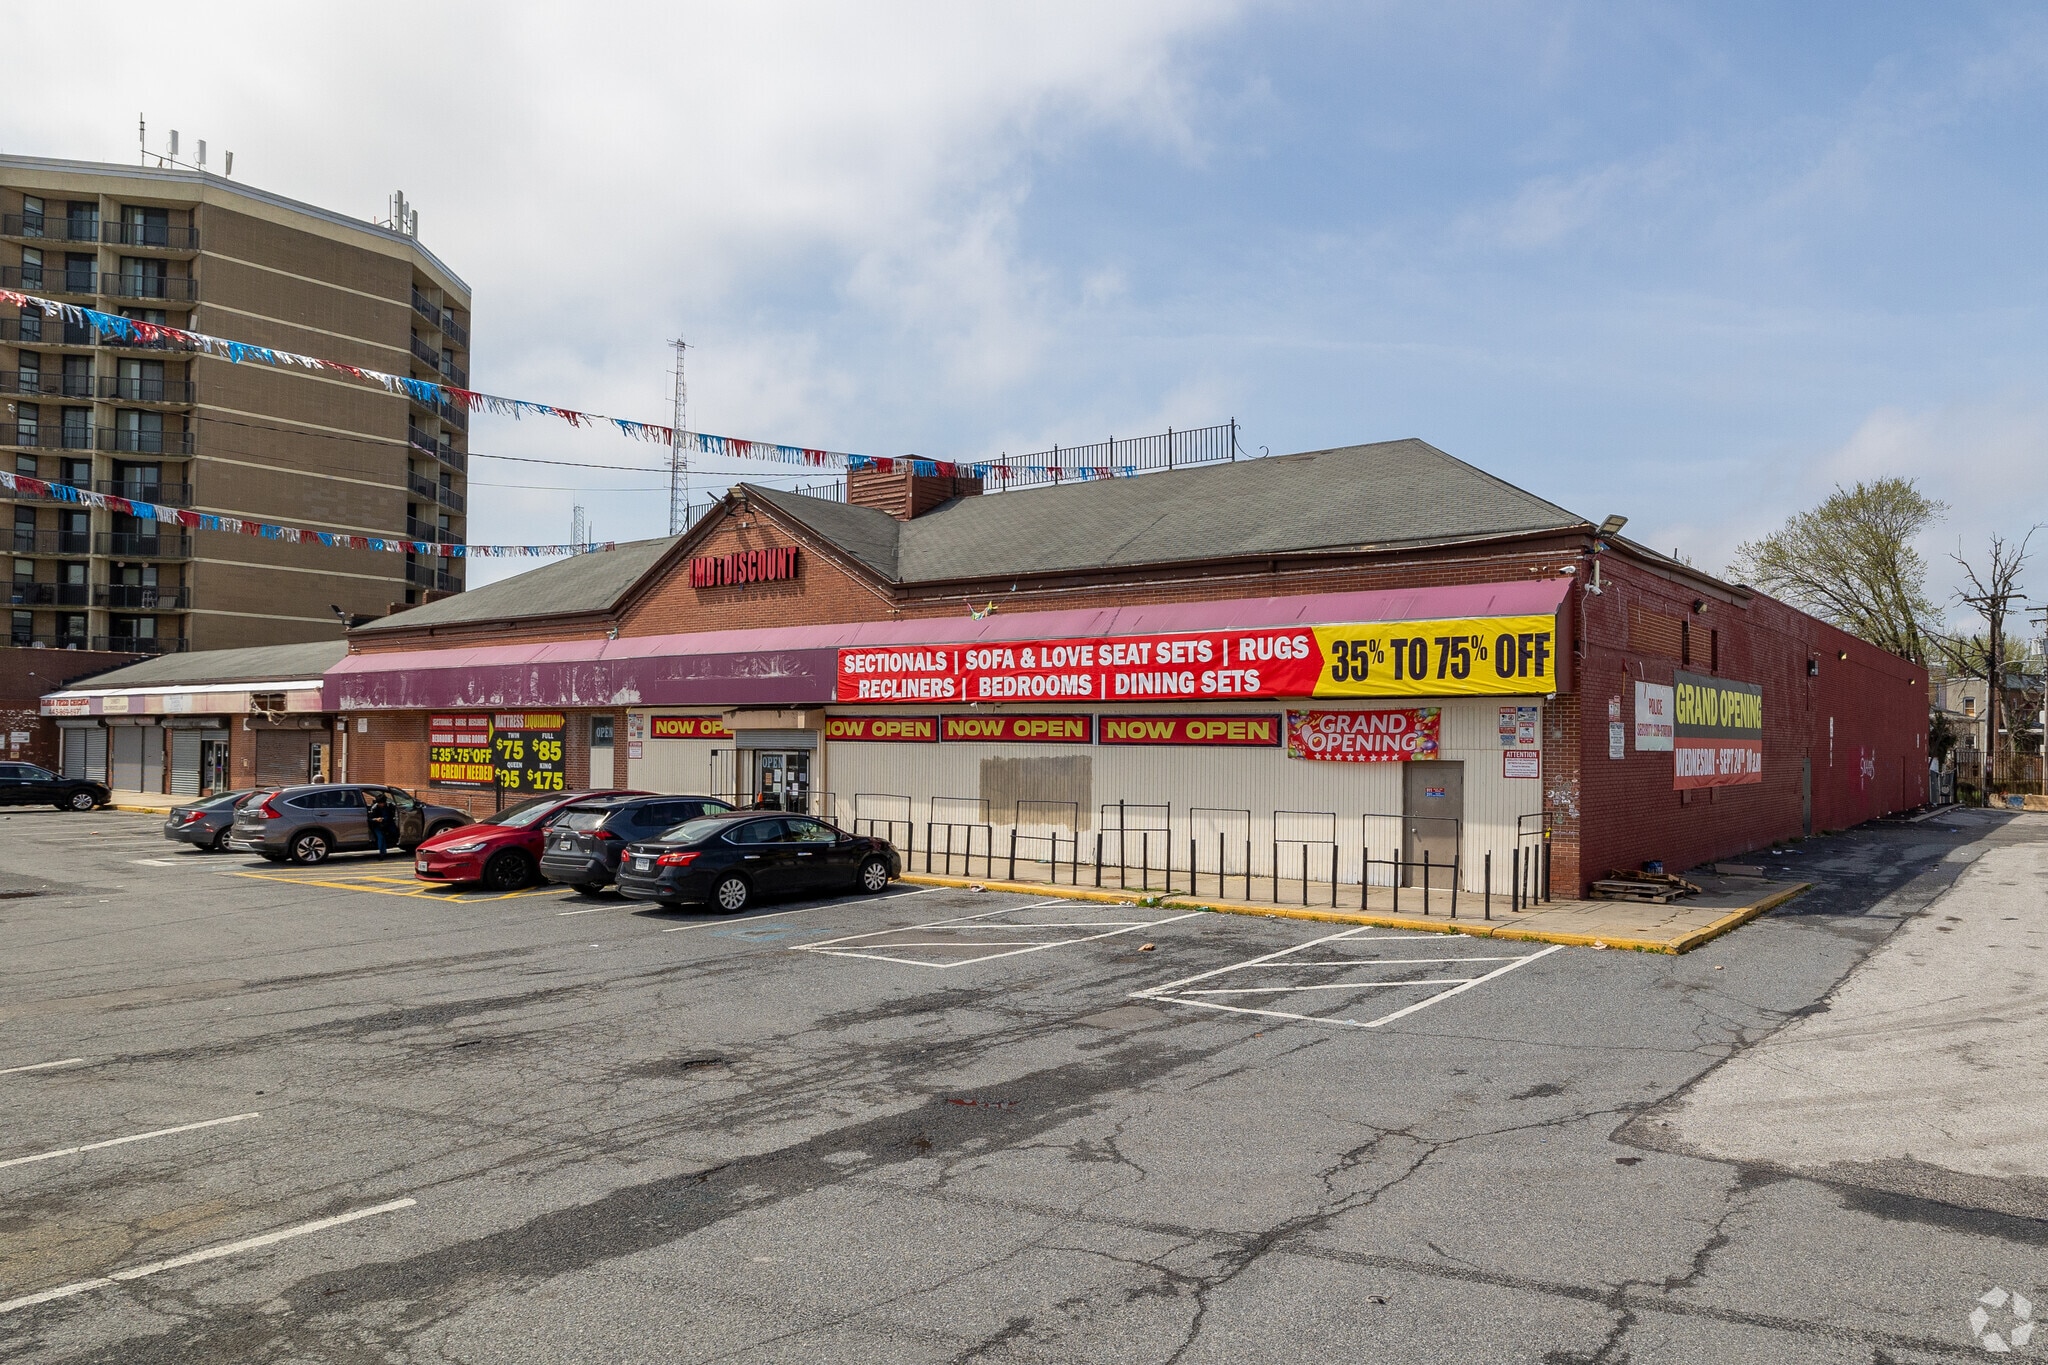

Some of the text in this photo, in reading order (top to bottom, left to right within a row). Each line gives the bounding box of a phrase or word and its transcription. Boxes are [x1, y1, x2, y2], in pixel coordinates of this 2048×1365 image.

[844, 651, 948, 674] SECTIONALS
[965, 649, 1015, 671] SOFA
[1020, 648, 1037, 669] &
[1041, 645, 1093, 668] LOVE
[1098, 642, 1151, 666] SEAT
[1156, 640, 1213, 663] SETS
[1239, 635, 1309, 661] RUGS
[1331, 632, 1551, 682] 35% TO 75% OFF
[858, 677, 955, 698] RECLINERS
[979, 674, 1092, 697] BEDROOMS
[1115, 671, 1195, 695] DINING
[1200, 669, 1260, 693] SETS
[1648, 697, 1663, 716] POLICE
[1676, 682, 1762, 729] GRAND OPENING
[495, 714, 561, 729] MATTRESS LIQUIDATION
[656, 720, 695, 734] NOW
[700, 720, 733, 734] OP
[871, 721, 931, 737] OPEN
[947, 720, 1082, 737] NOW OPEN
[1107, 721, 1269, 740] NOW OPEN
[596, 726, 613, 738] OPEN
[1308, 713, 1418, 752] GRAND OPENING
[496, 737, 562, 761] $75 $85
[506, 761, 523, 769] QUEEN
[762, 756, 784, 768] OPEN
[1675, 748, 1715, 777] WEDNESDAY
[1719, 748, 1734, 775] SEPT
[430, 763, 493, 781] NO CREDIT NEEDED
[527, 768, 563, 791] $175
